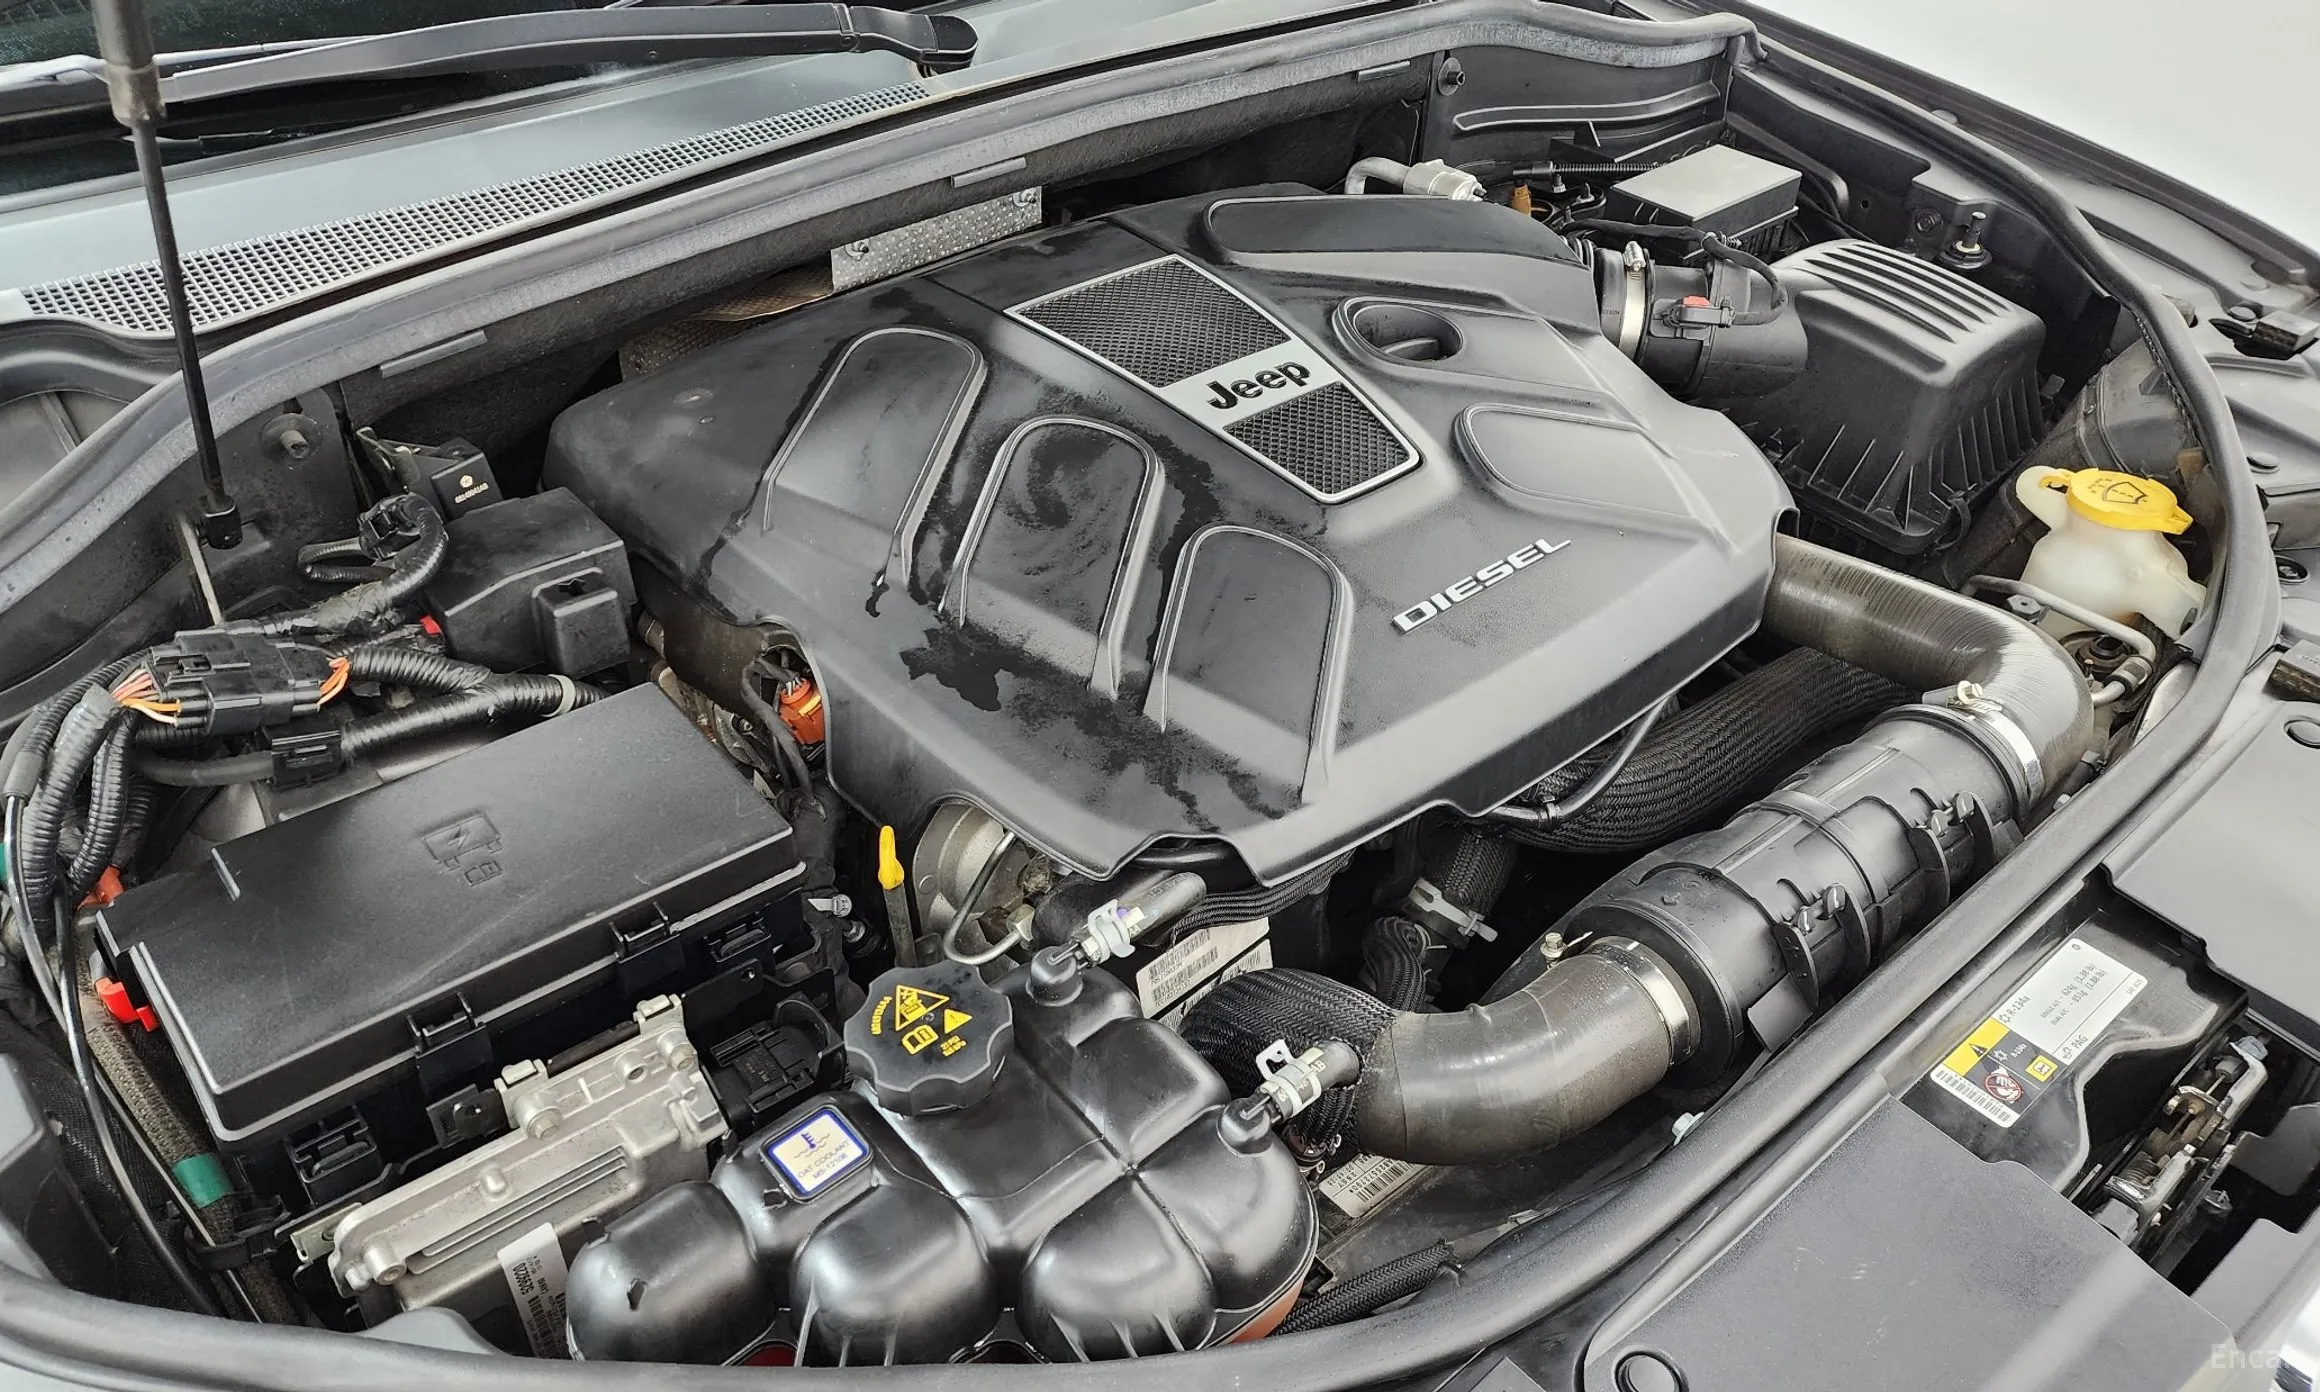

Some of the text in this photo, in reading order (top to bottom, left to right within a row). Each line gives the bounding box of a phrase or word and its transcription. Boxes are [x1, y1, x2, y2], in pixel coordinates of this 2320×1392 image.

[1206, 361, 1311, 410] Jeep
[1390, 538, 1572, 634] DIESEL
[2009, 995, 2031, 1017] R-134a
[2071, 1034, 2088, 1049] PAG
[814, 1140, 850, 1167] COOLANT
